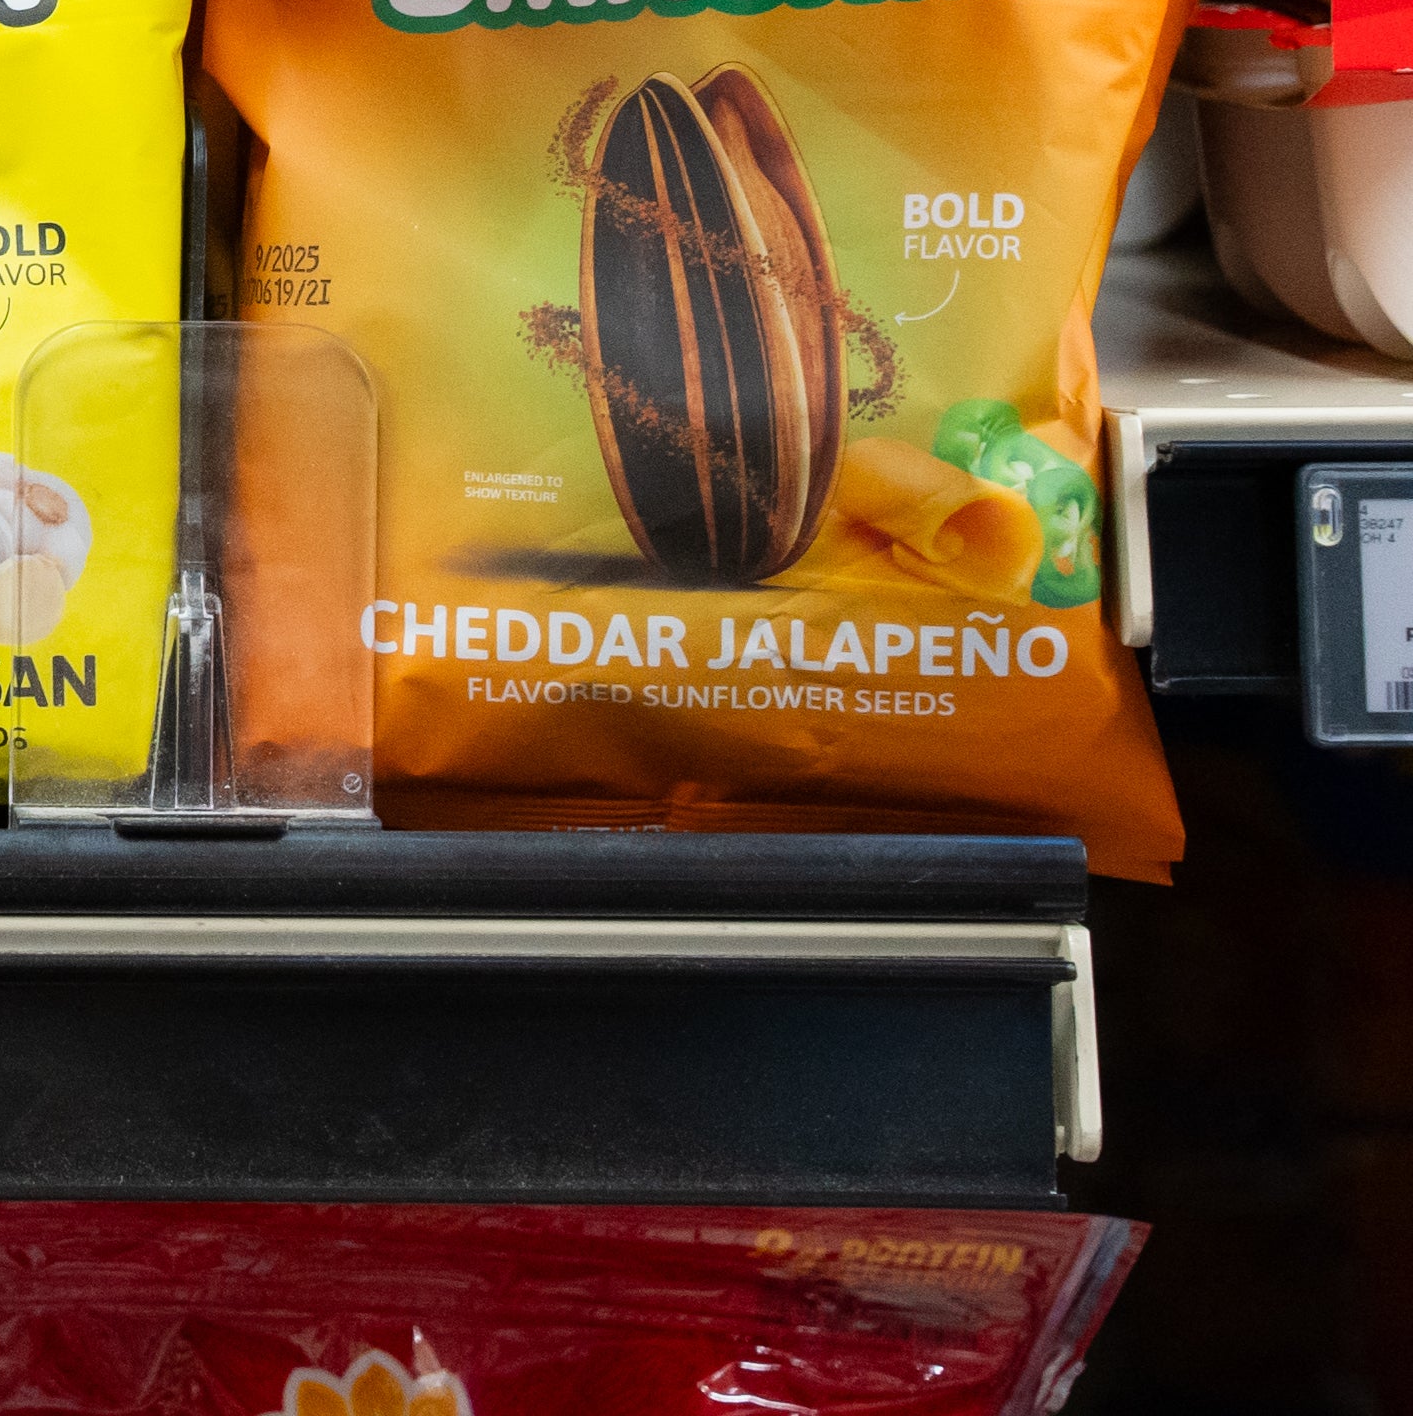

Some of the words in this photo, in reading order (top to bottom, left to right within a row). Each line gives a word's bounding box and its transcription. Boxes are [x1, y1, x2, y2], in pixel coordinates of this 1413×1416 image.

[904, 192, 1025, 231] BOLD
[255, 244, 320, 273] 9/2025
[904, 232, 1021, 262] FLAVOR
[463, 470, 544, 487] ENLARGENED
[547, 475, 563, 488] TO
[464, 486, 502, 499] SHOW
[504, 489, 558, 503] TEXTURE
[1362, 532, 1382, 544] OH
[1387, 532, 1396, 544] 4
[359, 599, 689, 669] CHEDDAR
[706, 611, 1069, 679] JALAPEÑO
[466, 675, 634, 707] FLAVORED
[642, 681, 846, 715] SUNFLOWER
[854, 686, 956, 718] SEEDS
